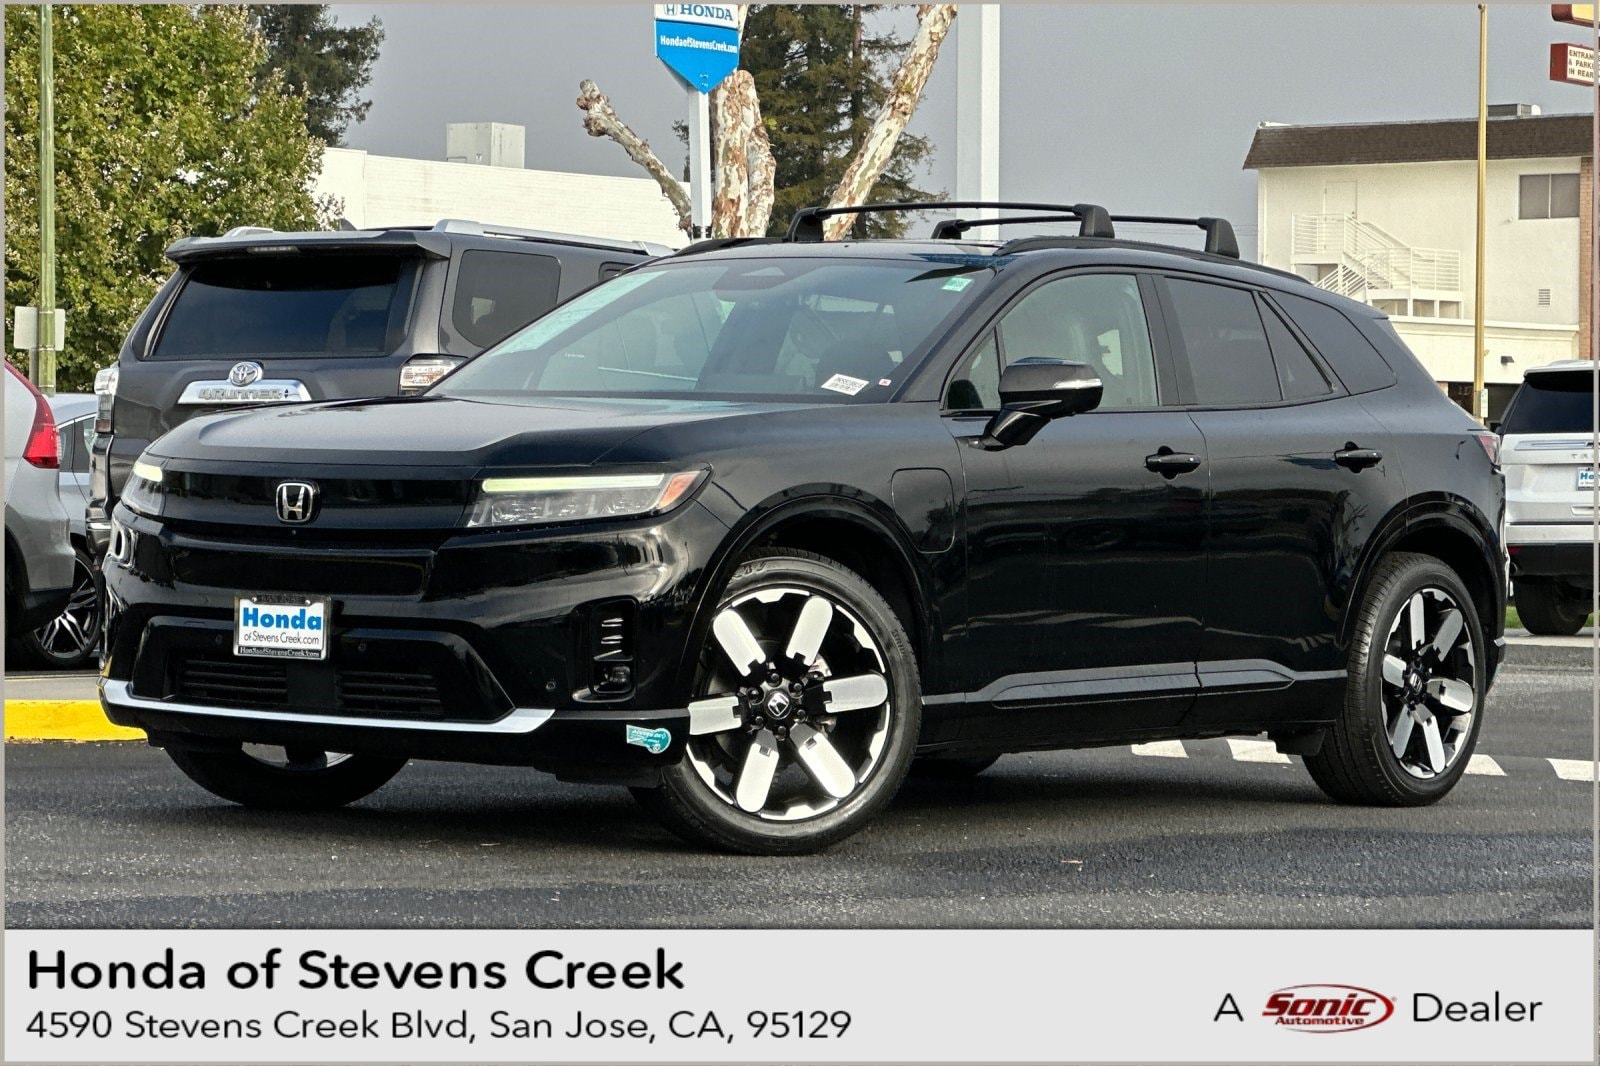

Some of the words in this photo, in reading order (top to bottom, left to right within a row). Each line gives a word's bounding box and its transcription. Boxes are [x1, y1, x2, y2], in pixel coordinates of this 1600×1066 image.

[679, 4, 734, 21] HONDA
[198, 388, 281, 400] 4RUNNER
[243, 607, 321, 630] Honda
[244, 633, 252, 642] of
[252, 630, 279, 643] Stevens
[279, 631, 320, 645] Creek.com
